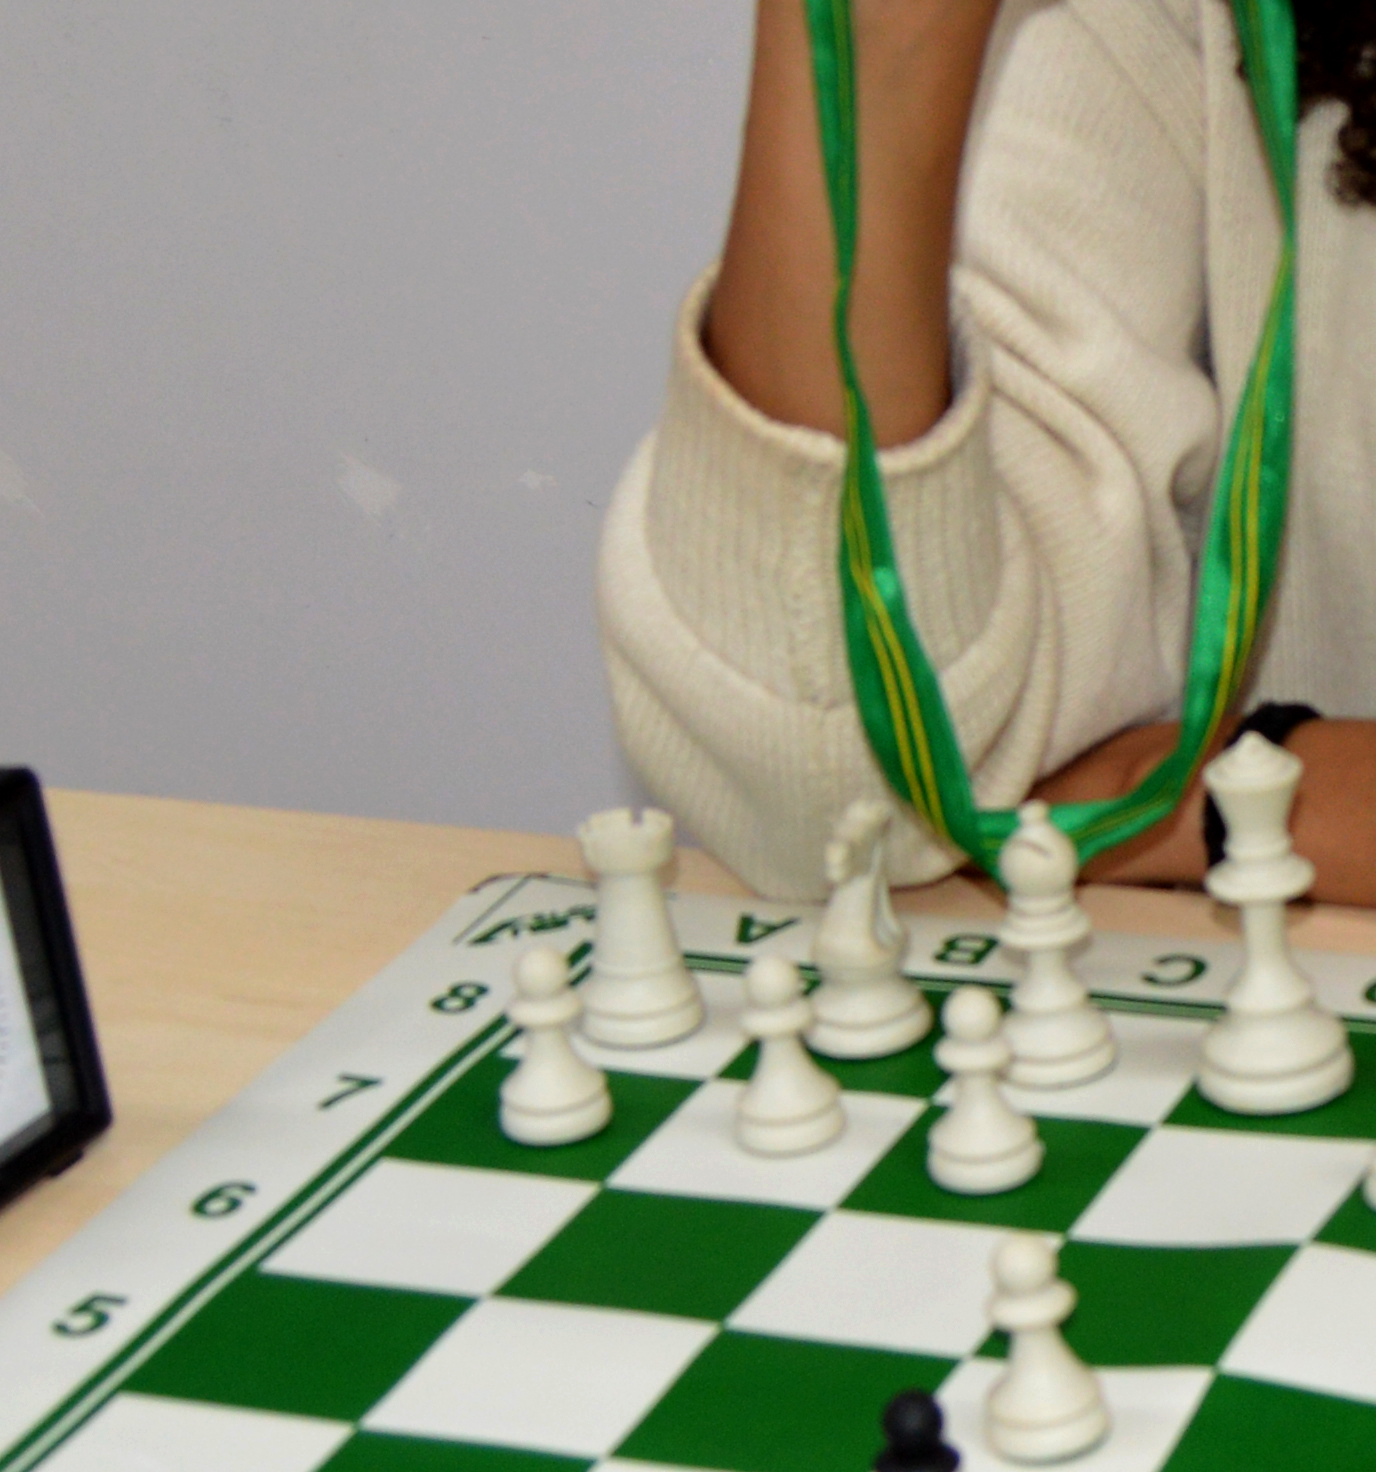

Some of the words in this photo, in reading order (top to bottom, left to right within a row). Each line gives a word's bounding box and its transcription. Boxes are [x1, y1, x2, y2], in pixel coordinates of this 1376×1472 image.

[735, 913, 799, 946] A
[933, 933, 1002, 967] B
[1141, 953, 1210, 988] C
[429, 982, 490, 1014] 8
[321, 1074, 382, 1109] 7
[190, 1181, 258, 1218] 6
[52, 1293, 128, 1337] 5
